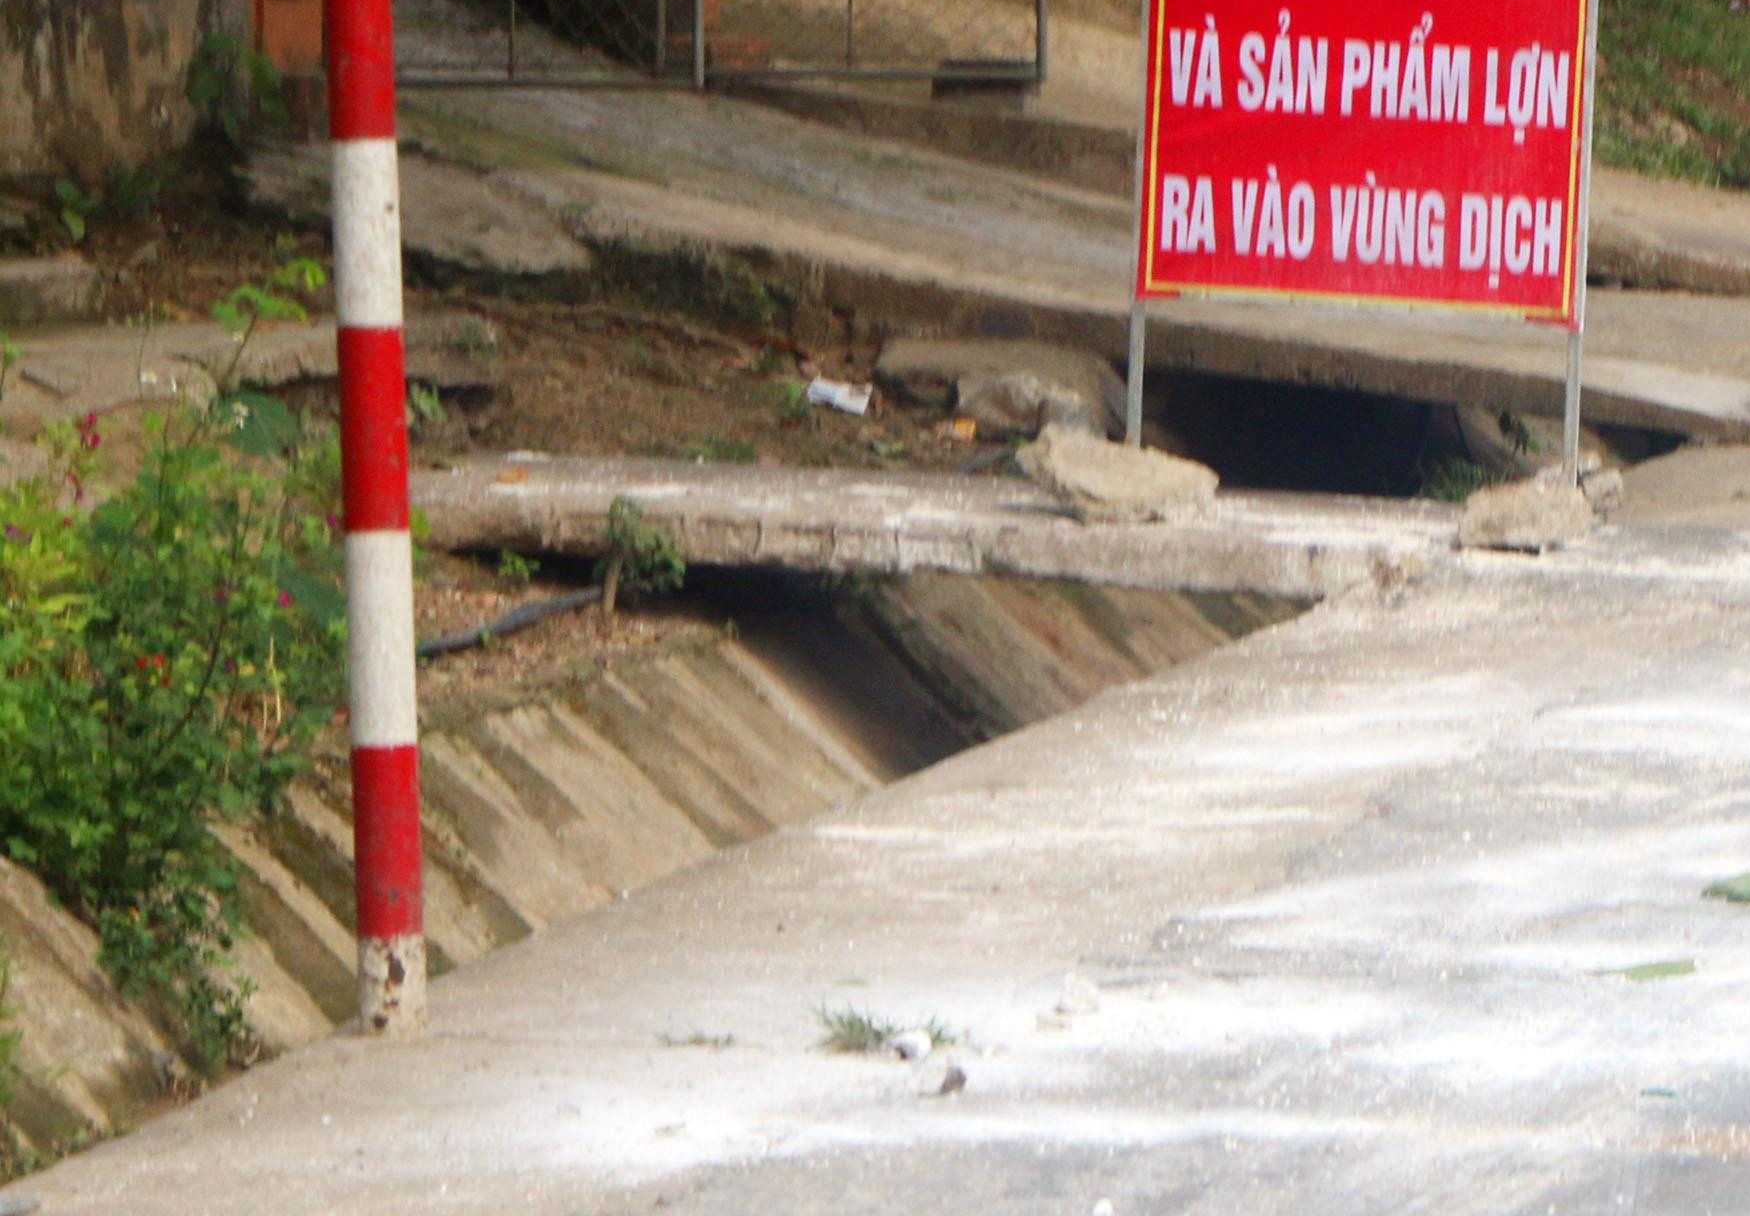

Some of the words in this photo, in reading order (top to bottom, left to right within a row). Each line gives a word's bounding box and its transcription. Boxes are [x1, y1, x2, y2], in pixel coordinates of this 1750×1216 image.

[1169, 14, 1223, 108] VÀ
[1237, 9, 1329, 115] SẢN
[1340, 12, 1471, 123] PHẨM
[1483, 43, 1570, 145] LỢN
[1160, 175, 1216, 253] RA
[1231, 165, 1316, 260] VÀO
[1329, 170, 1446, 269] VÙNG
[1458, 194, 1563, 290] DỊCH
